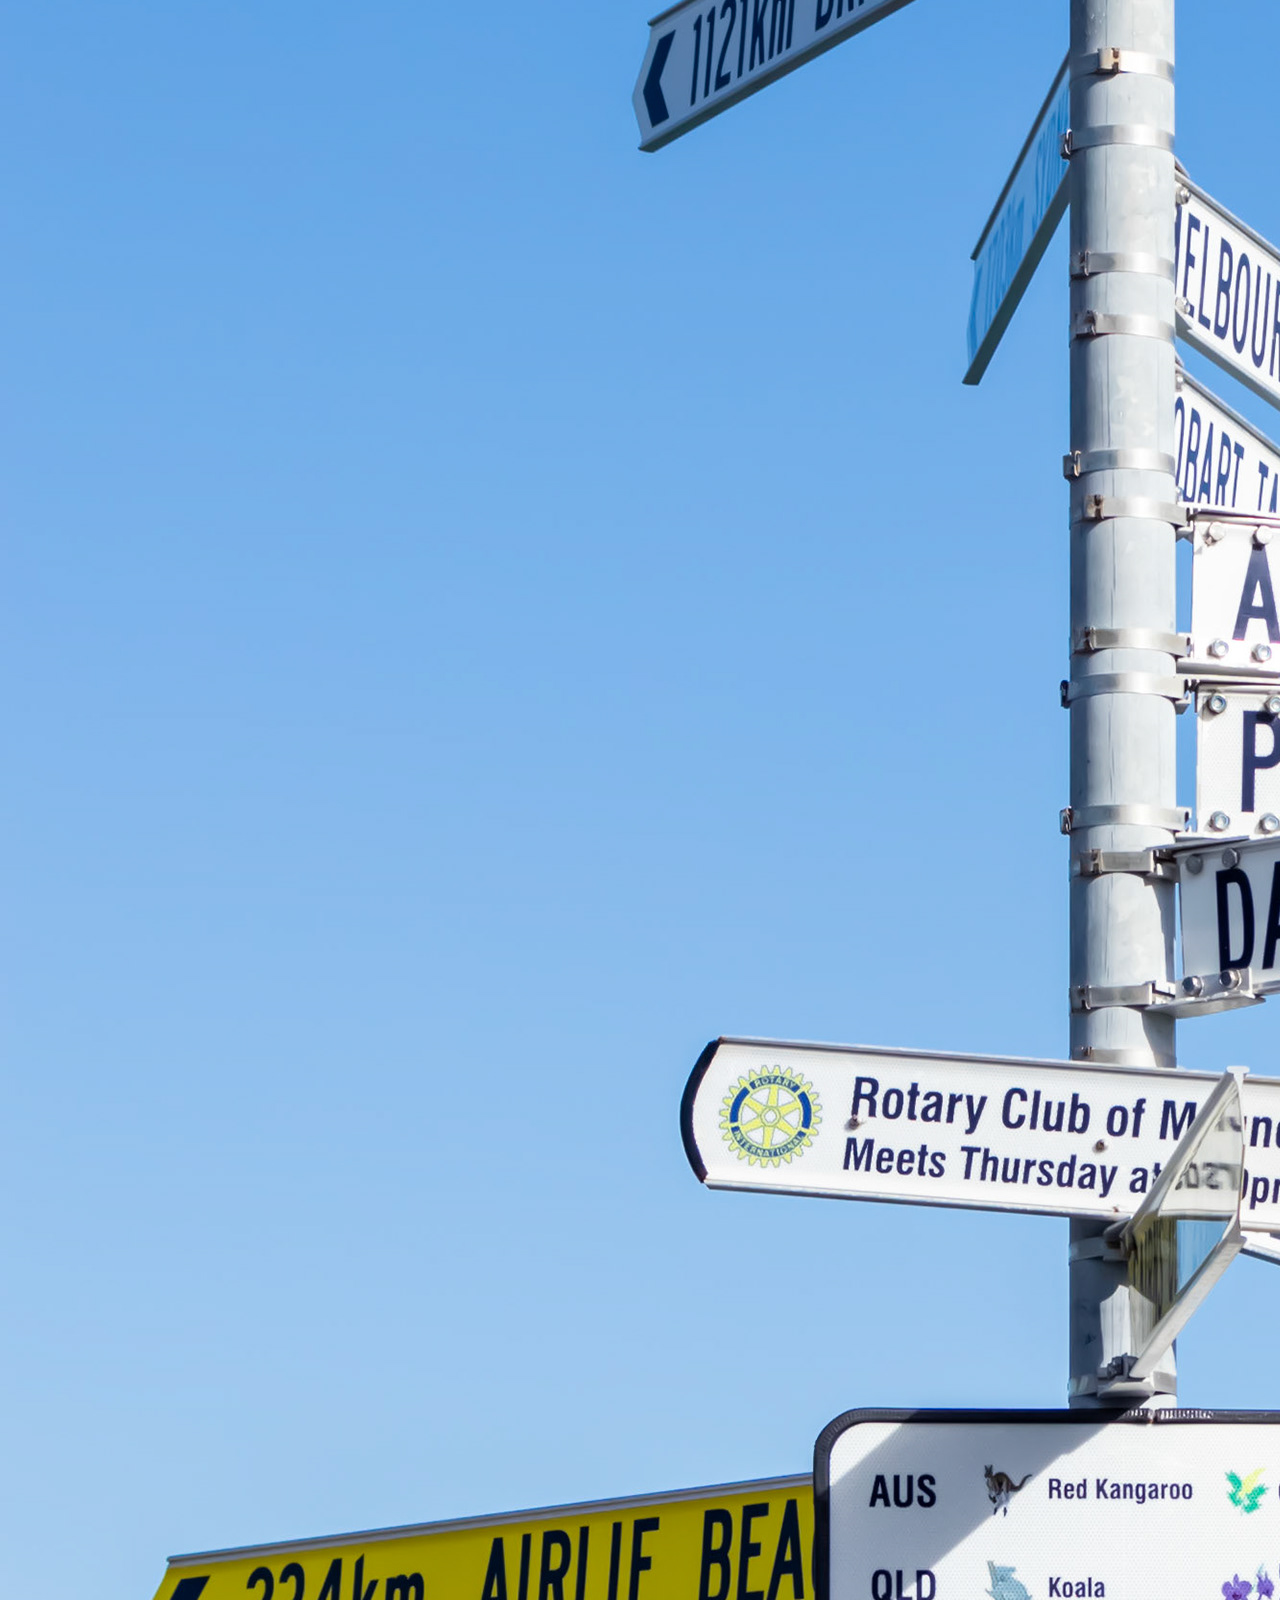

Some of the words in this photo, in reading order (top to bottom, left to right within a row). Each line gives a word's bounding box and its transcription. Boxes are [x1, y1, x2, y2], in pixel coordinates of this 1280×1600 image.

[1175, 396, 1245, 508] OBART
[753, 1076, 797, 1090] ROTARY
[851, 1076, 987, 1135] Rotary
[1002, 1087, 1091, 1134] Club
[1106, 1098, 1146, 1138] of
[732, 1130, 804, 1158] INTERNATIONAL
[843, 1137, 947, 1178] Meets
[961, 1145, 1118, 1198] Thursday
[868, 1474, 937, 1508] AUS
[1048, 1479, 1088, 1499] Red
[1095, 1479, 1193, 1504] Kangaroo
[1048, 1577, 1106, 1598] Koala
